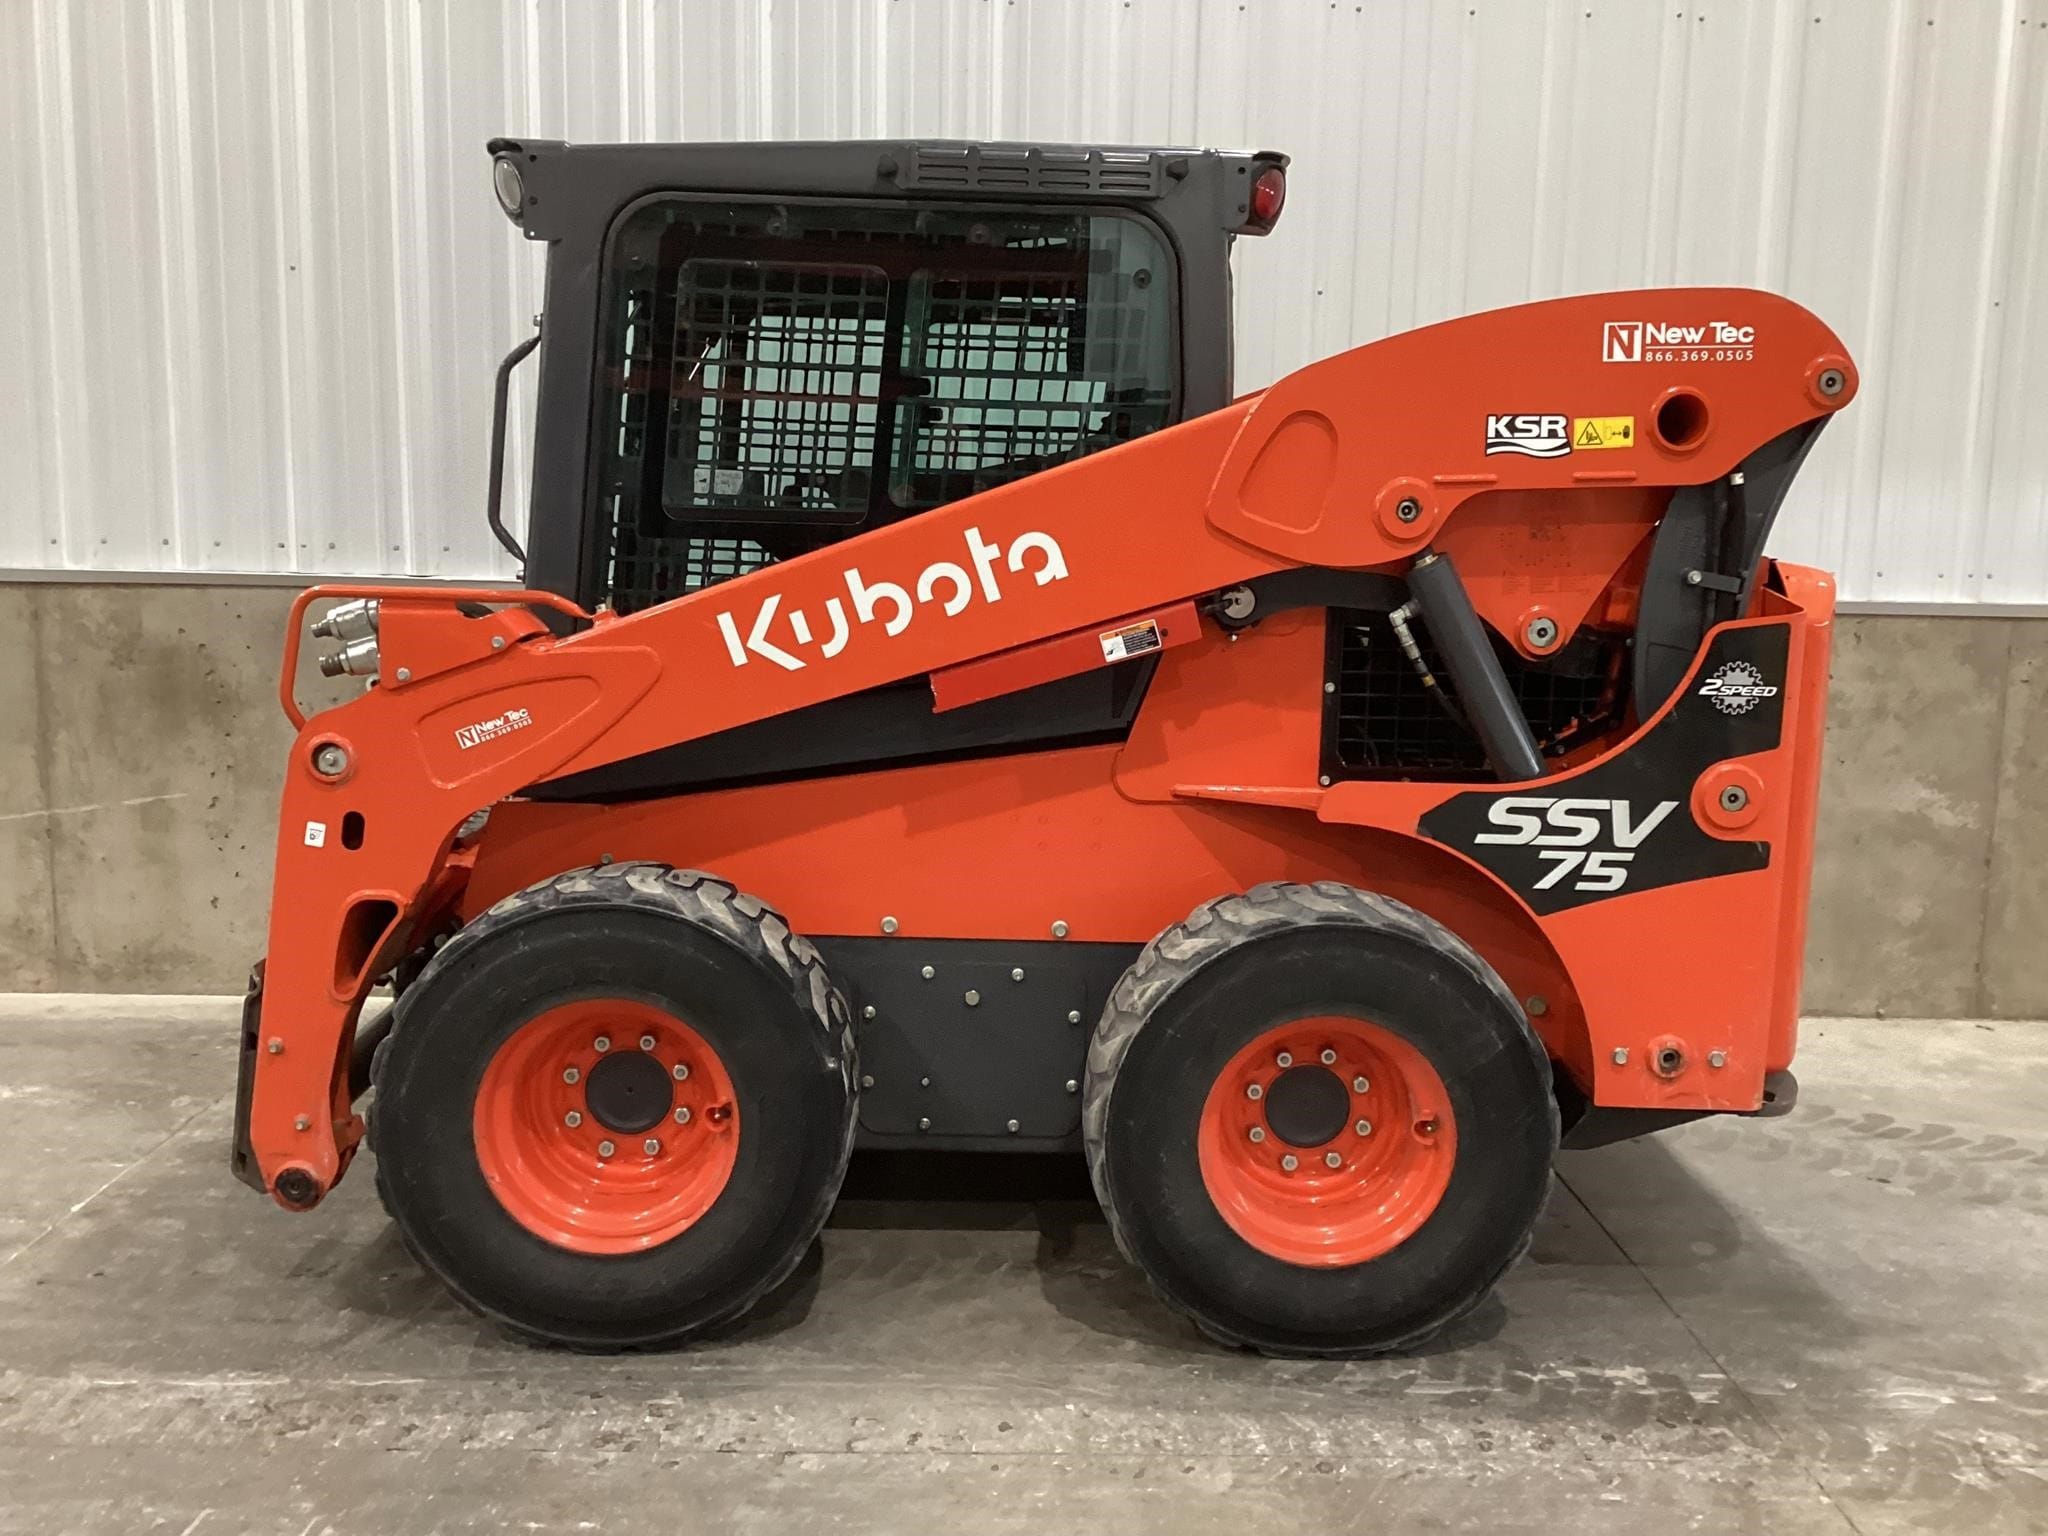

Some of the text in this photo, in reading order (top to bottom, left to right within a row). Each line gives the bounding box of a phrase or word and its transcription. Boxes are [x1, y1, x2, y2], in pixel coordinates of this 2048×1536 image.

[1645, 321, 1755, 344] New Tec
[1645, 350, 1754, 362] 866.369.0505
[1487, 415, 1568, 438] KSR
[715, 525, 1070, 672] Kubota
[474, 708, 529, 734] New Tec
[1473, 796, 1681, 848] SSV
[1532, 849, 1636, 892] 75
